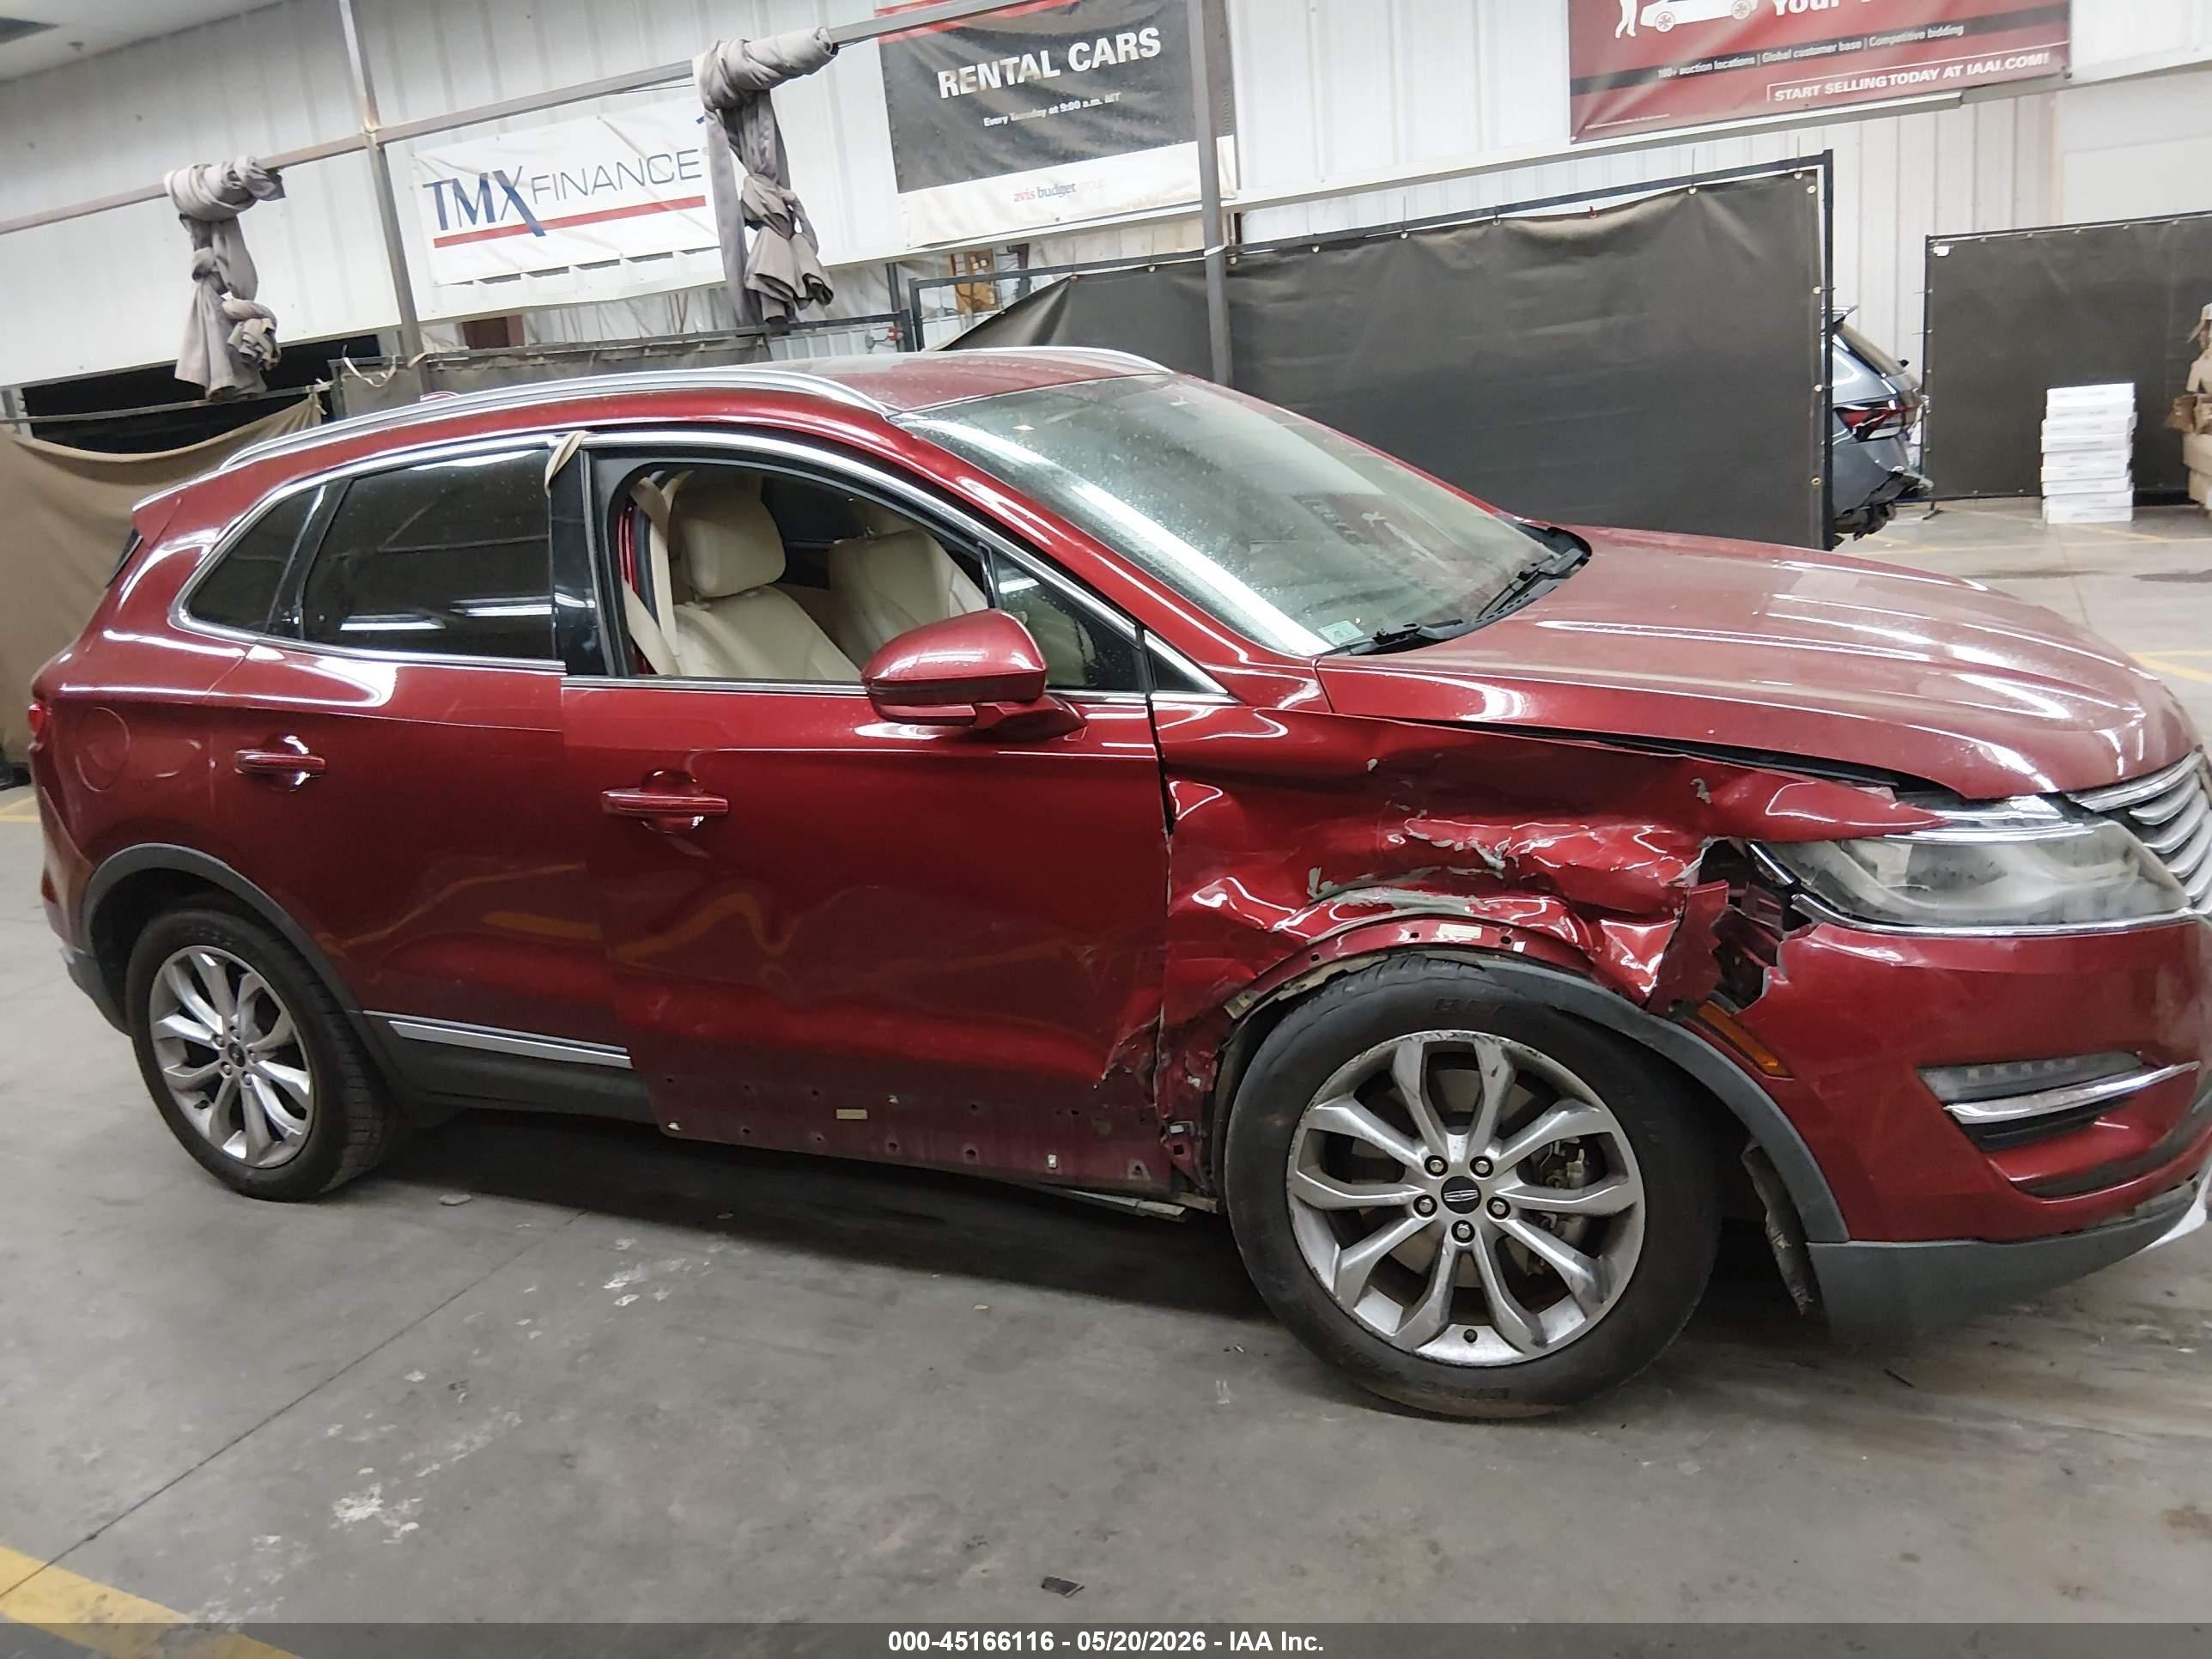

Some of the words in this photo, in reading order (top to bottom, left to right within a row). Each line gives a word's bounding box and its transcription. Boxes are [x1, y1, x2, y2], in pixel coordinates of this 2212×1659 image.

[937, 50, 1060, 99] RENTAL
[1067, 27, 1162, 71] CARS
[1679, 62, 1713, 76] auction
[1714, 57, 1755, 70] locations
[1762, 49, 1791, 63] Global
[1793, 44, 1837, 58] customer
[1838, 40, 1862, 52] base
[1869, 30, 1926, 47] Competitive
[1927, 24, 1965, 39] bidding
[1773, 84, 1822, 101] START
[1825, 76, 1887, 94] SELLING
[1887, 68, 1941, 85] TODAY
[1942, 64, 1965, 78] AT
[1966, 52, 2050, 75] IAAI.COM!
[422, 165, 547, 238] TMX
[531, 149, 703, 204] FINANCE
[1013, 186, 1036, 203] avis
[1036, 183, 1077, 198] budget
